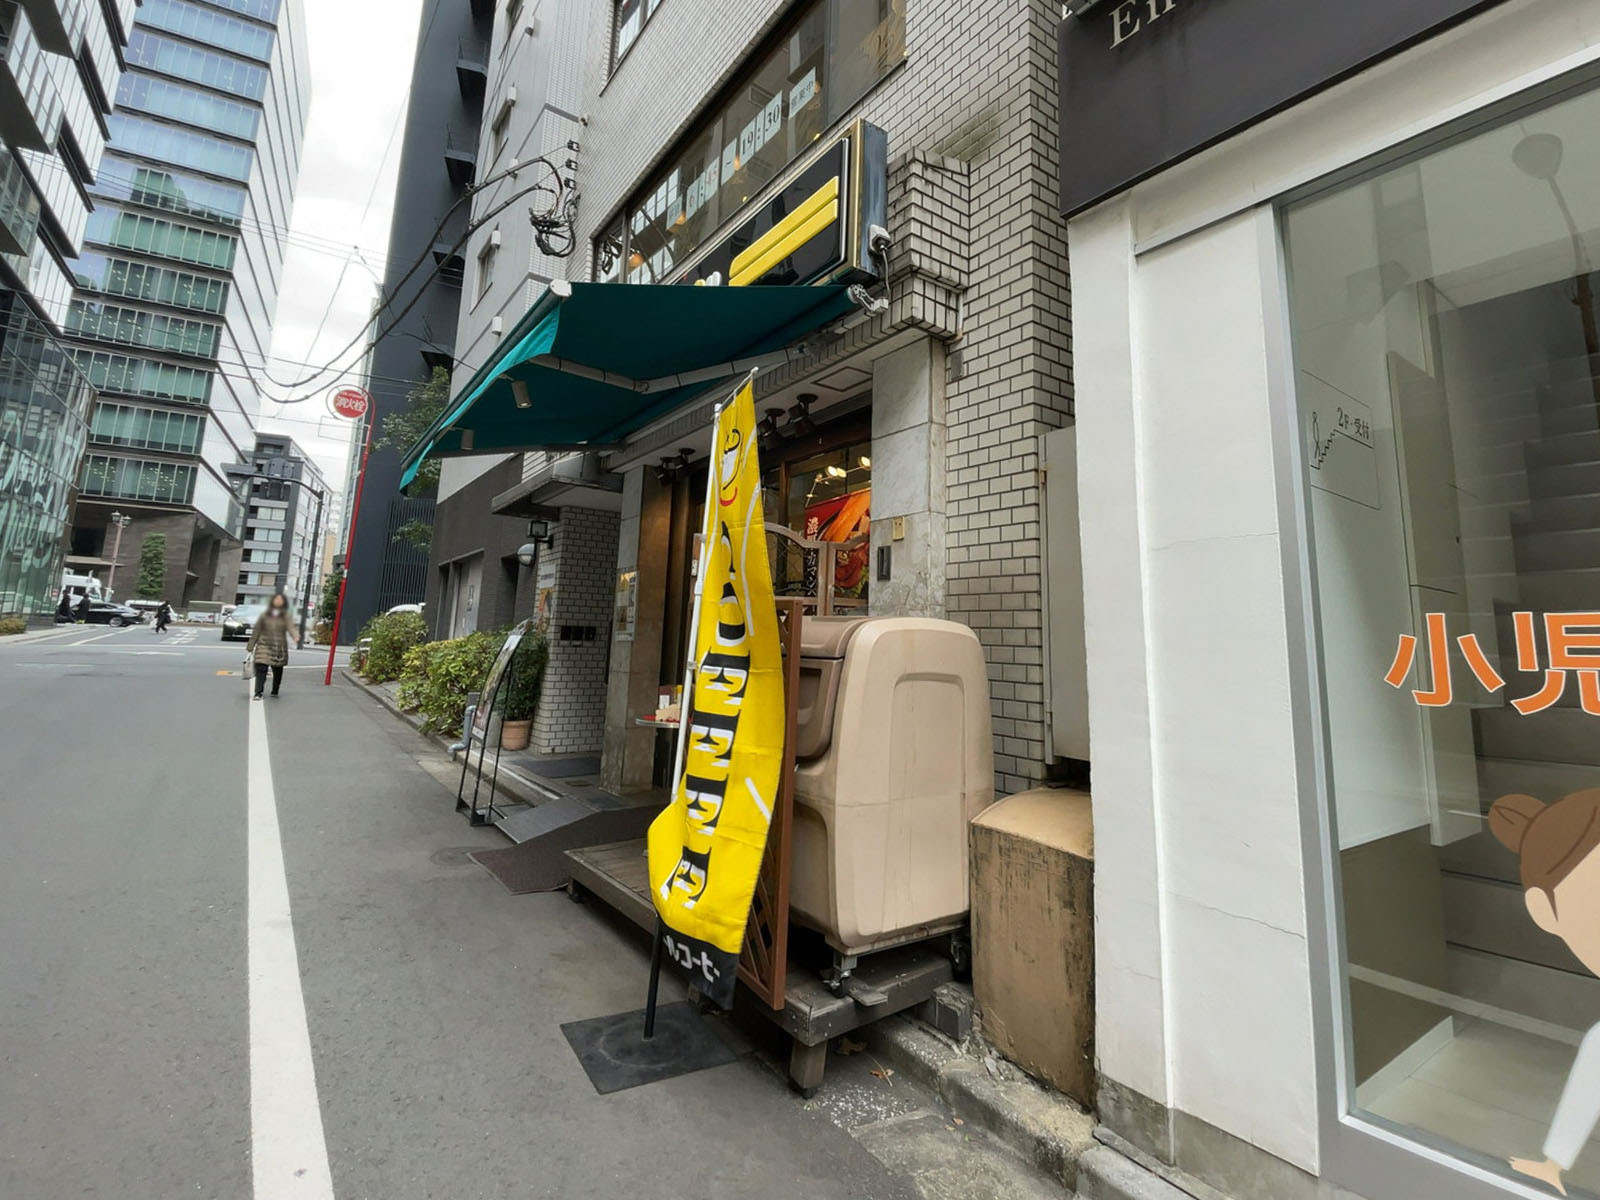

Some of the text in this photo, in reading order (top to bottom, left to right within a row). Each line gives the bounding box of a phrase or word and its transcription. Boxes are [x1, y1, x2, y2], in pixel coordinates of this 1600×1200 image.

[336, 396, 365, 412] 消火栓
[1384, 611, 1600, 716] 小児
